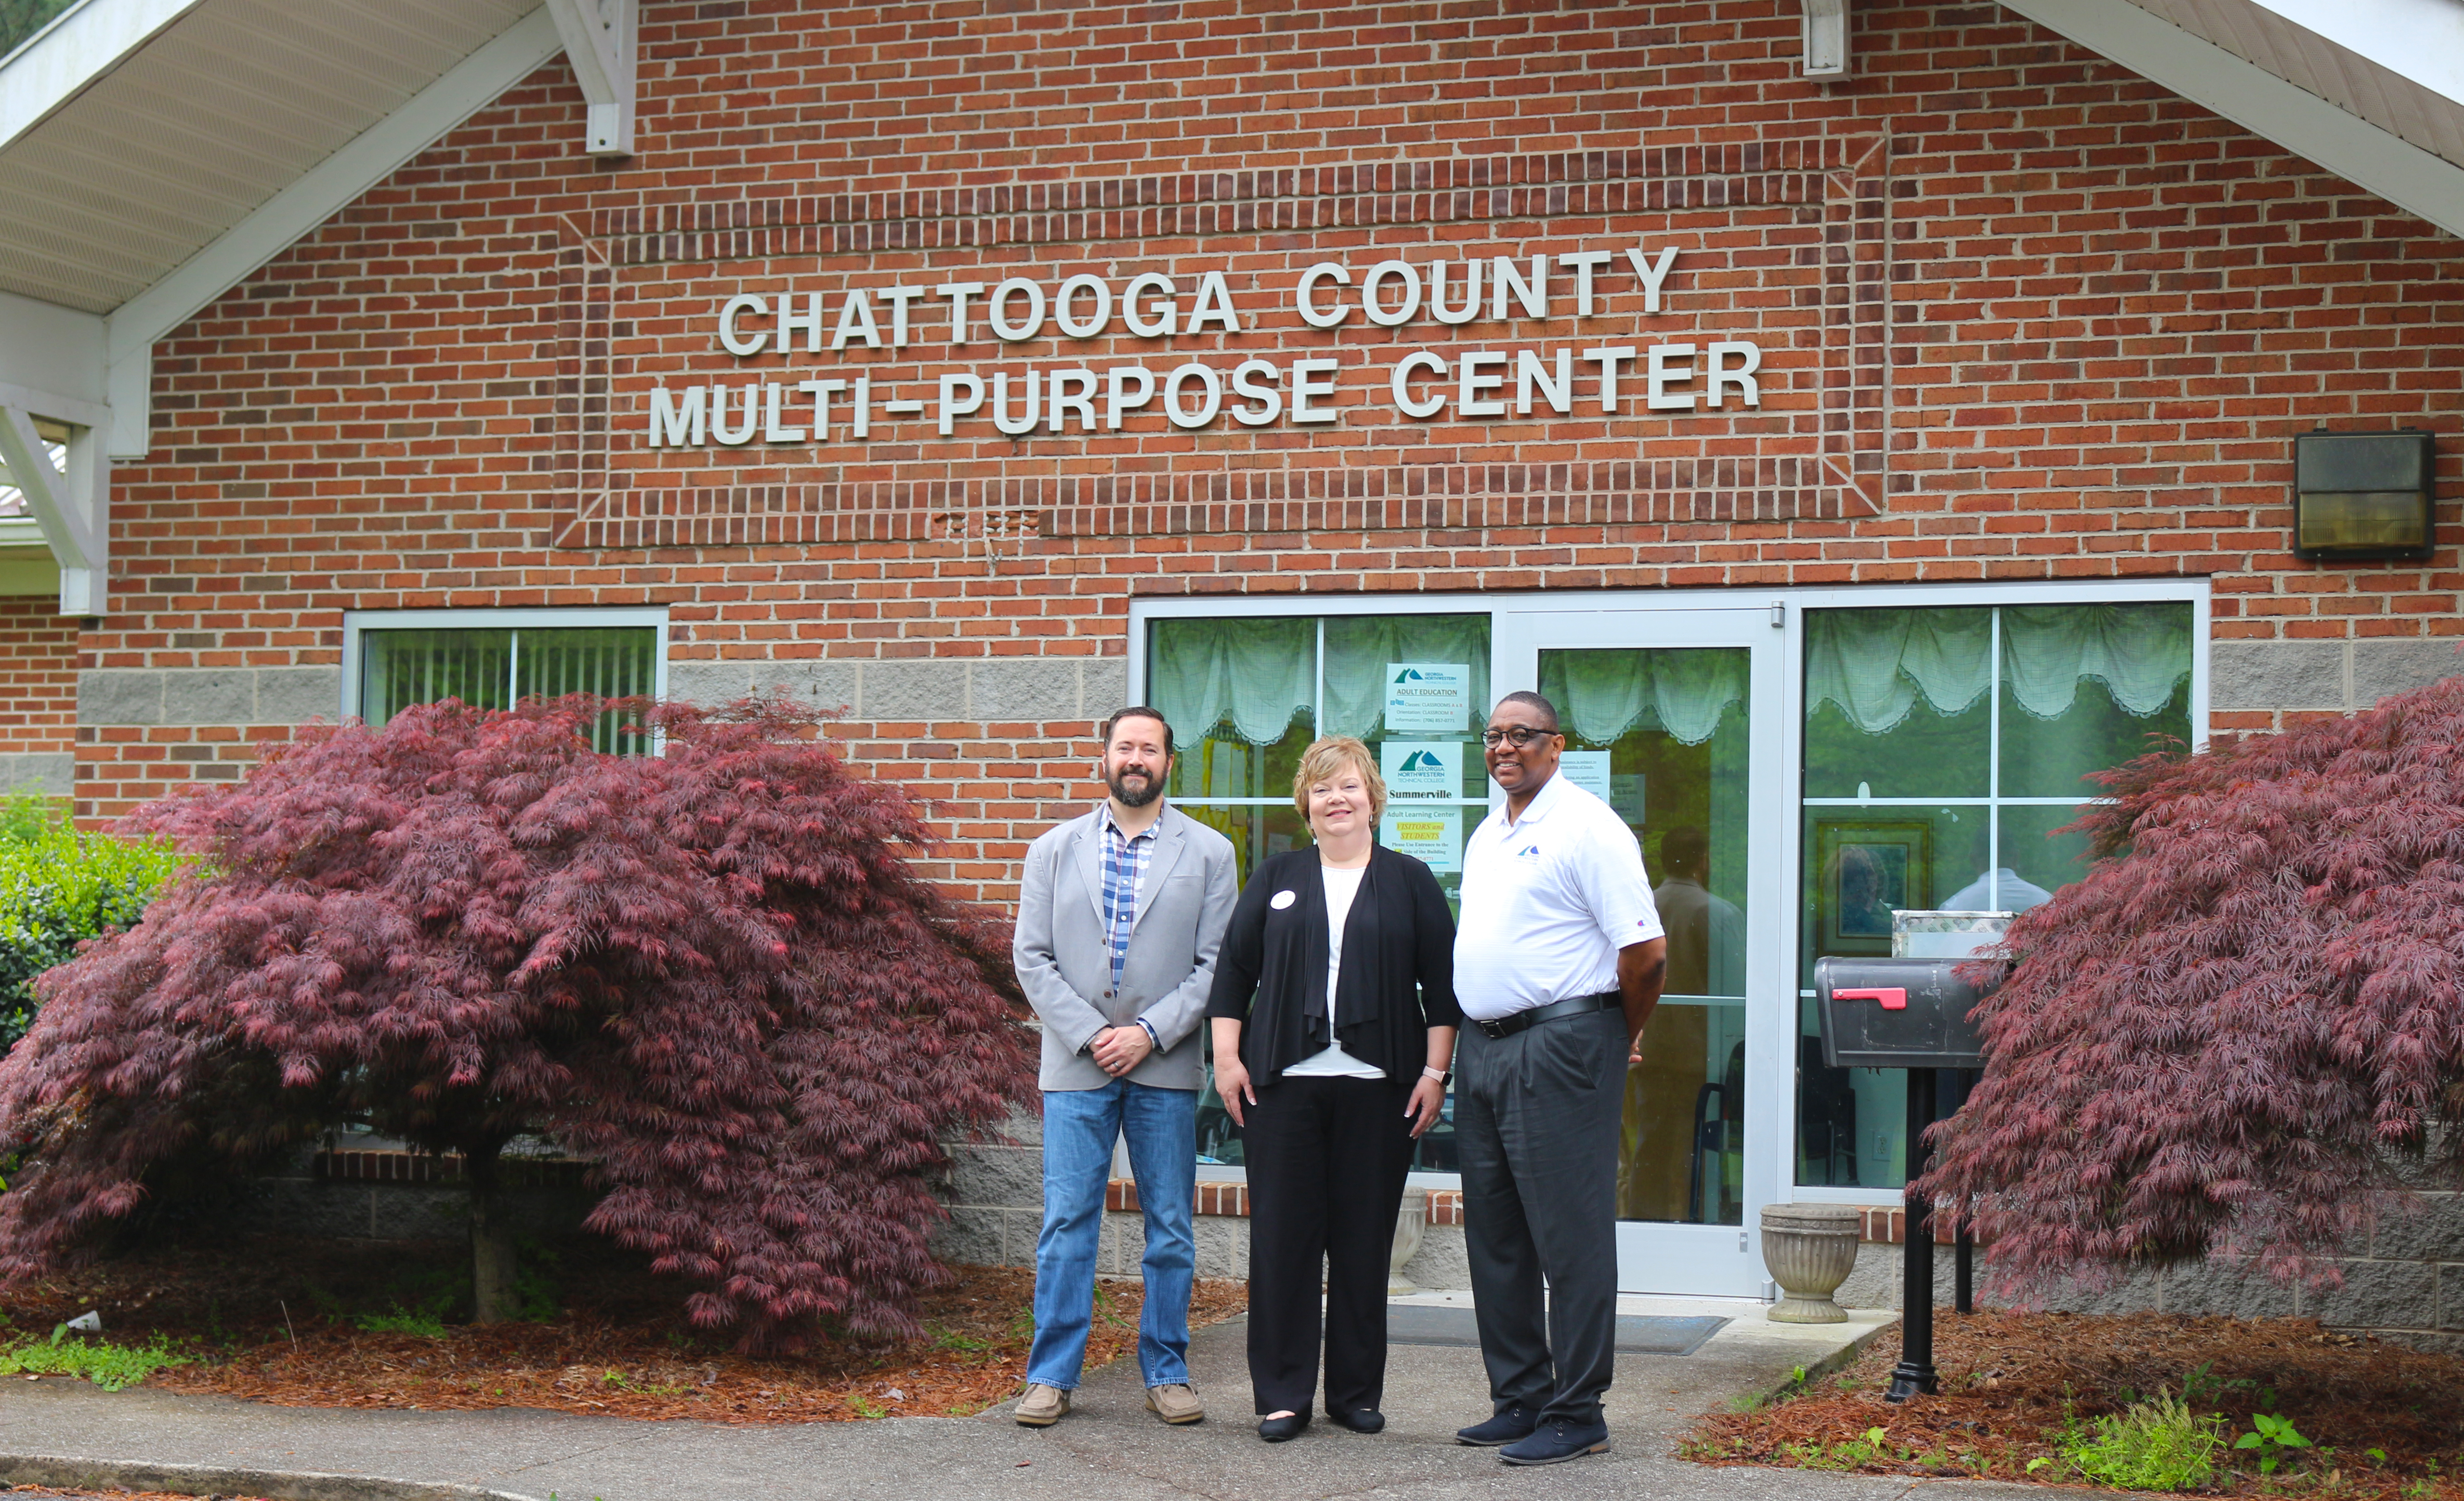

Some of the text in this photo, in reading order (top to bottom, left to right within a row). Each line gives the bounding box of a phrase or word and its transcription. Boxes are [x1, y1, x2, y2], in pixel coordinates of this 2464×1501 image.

[718, 246, 1679, 356] CHATTOOGA COUNTY
[648, 340, 1761, 447] MULTI-PURPOSE CENTER
[1389, 790, 1452, 798] Summerville
